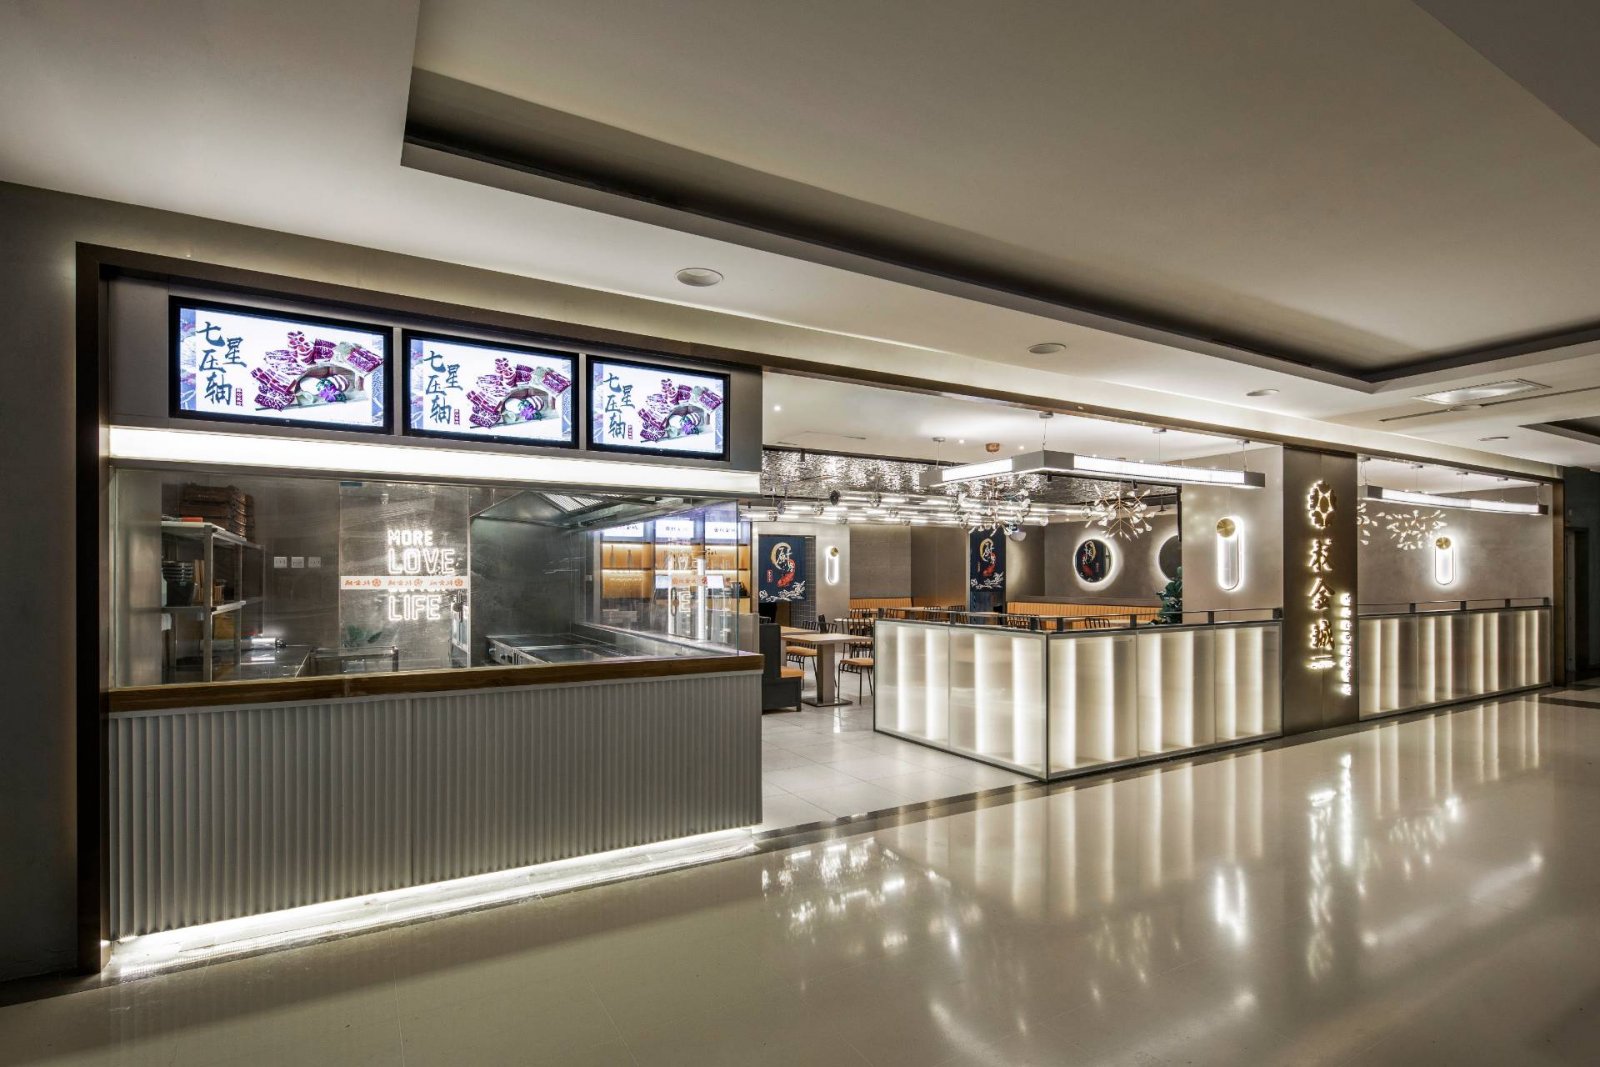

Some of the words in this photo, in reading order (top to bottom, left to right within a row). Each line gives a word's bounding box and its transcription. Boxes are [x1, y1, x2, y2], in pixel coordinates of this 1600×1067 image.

[388, 530, 433, 546] MORE
[388, 548, 455, 574] LOVE
[388, 595, 442, 621] LIFE
